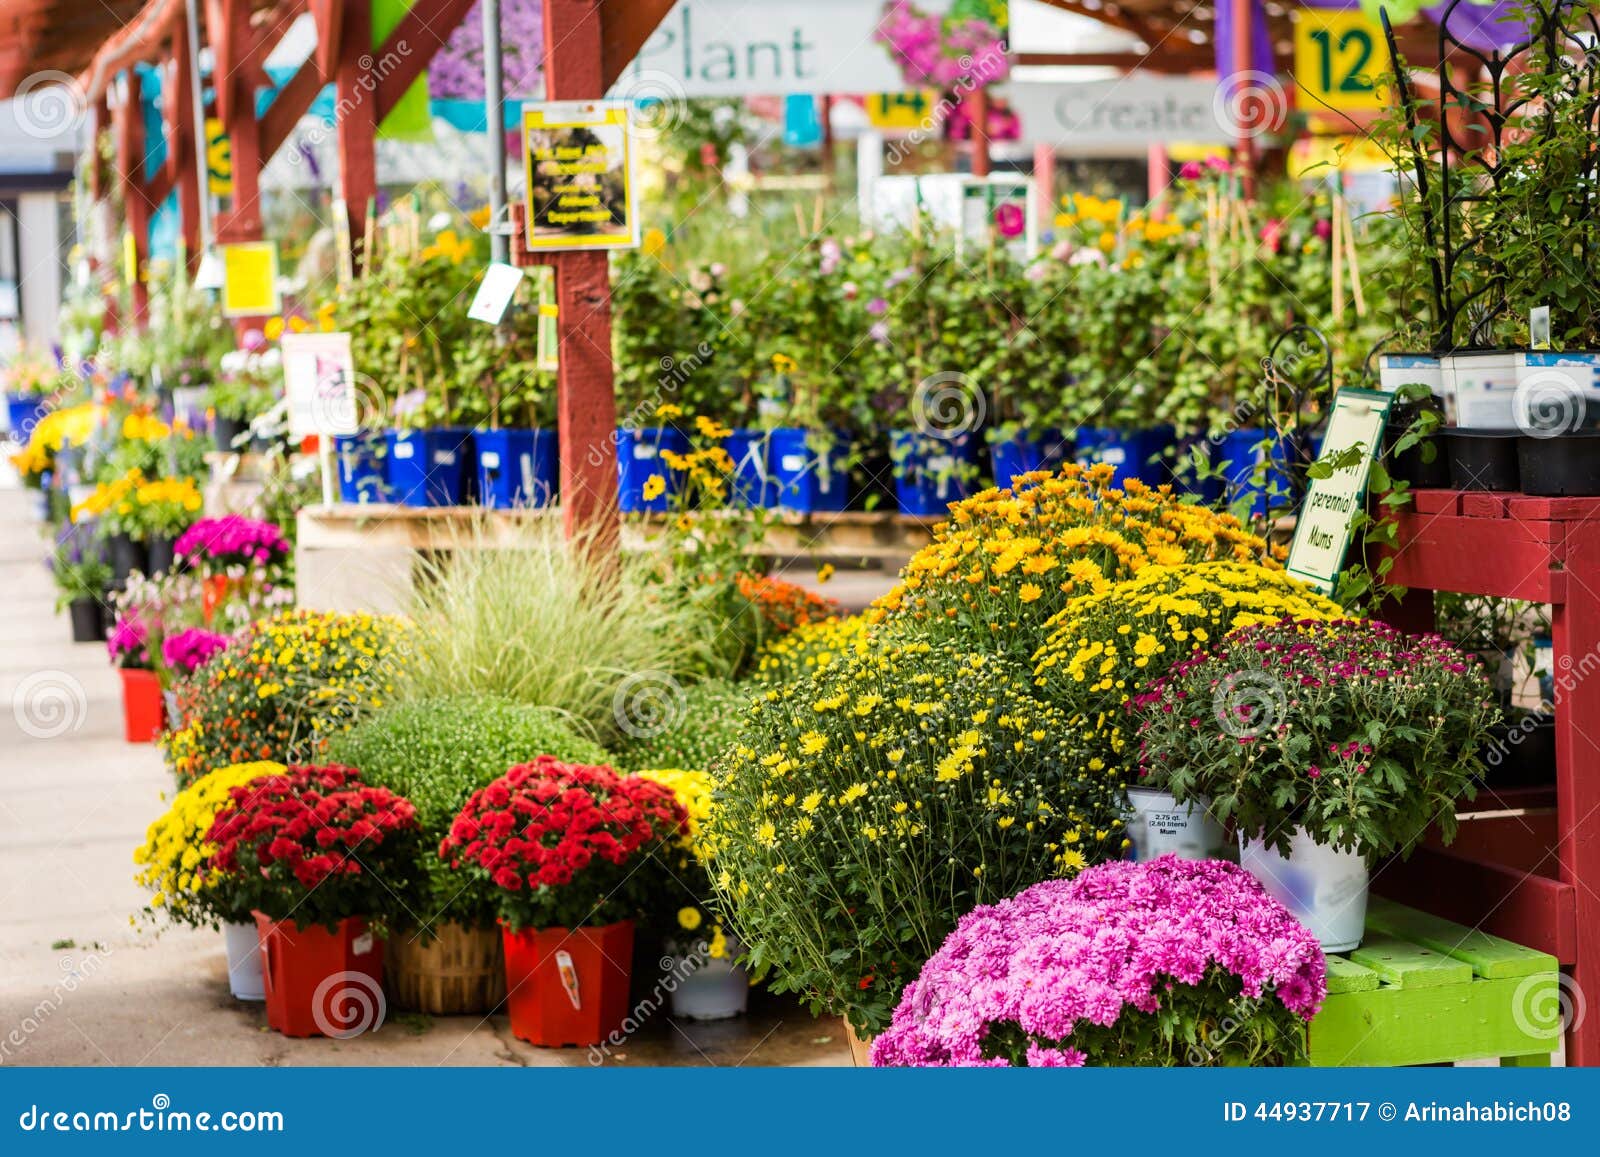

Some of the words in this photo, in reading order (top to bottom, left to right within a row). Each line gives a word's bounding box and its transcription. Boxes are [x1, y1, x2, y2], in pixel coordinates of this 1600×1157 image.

[1310, 29, 1375, 93] 12
[1054, 87, 1205, 131] Create
[1310, 491, 1355, 513] perennial
[1307, 524, 1333, 550] Mums
[1159, 828, 1177, 836] Mum
